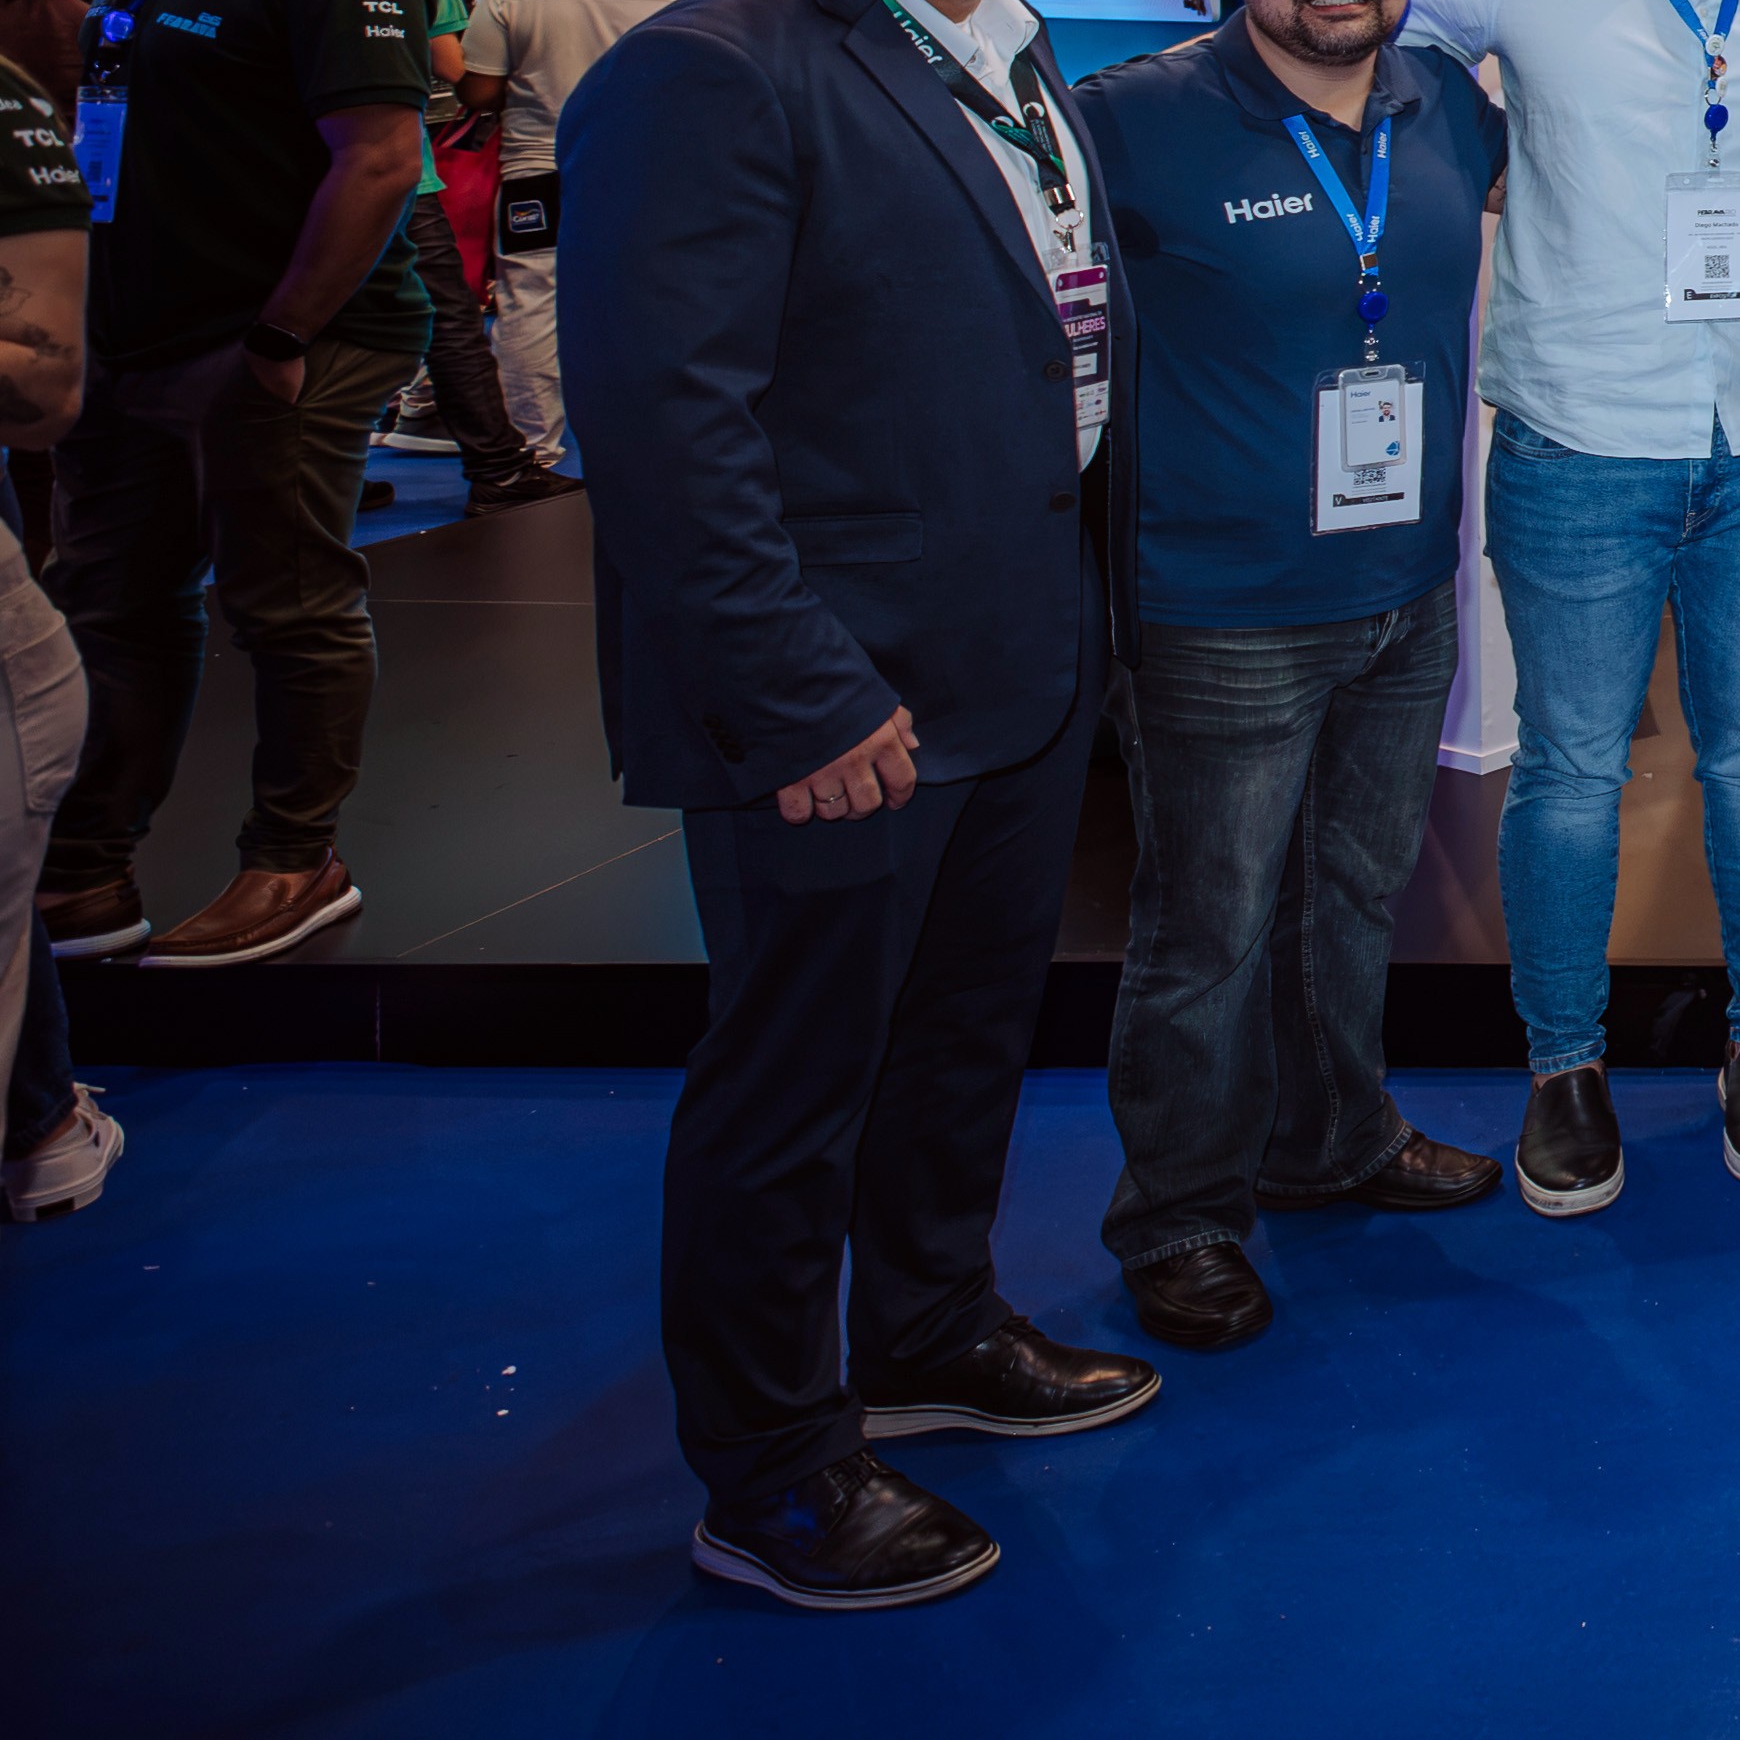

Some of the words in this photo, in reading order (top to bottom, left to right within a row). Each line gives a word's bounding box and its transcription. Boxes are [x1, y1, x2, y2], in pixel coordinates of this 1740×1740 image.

[362, 1, 404, 15] TCL
[365, 25, 405, 39] Haier
[13, 128, 65, 147] TCL
[1298, 131, 1320, 159] Haier
[1376, 132, 1388, 159] Haier
[1224, 193, 1313, 224] Haier
[1366, 215, 1381, 243] Haier
[1350, 390, 1371, 399] Haier
[1335, 497, 1342, 506] V
